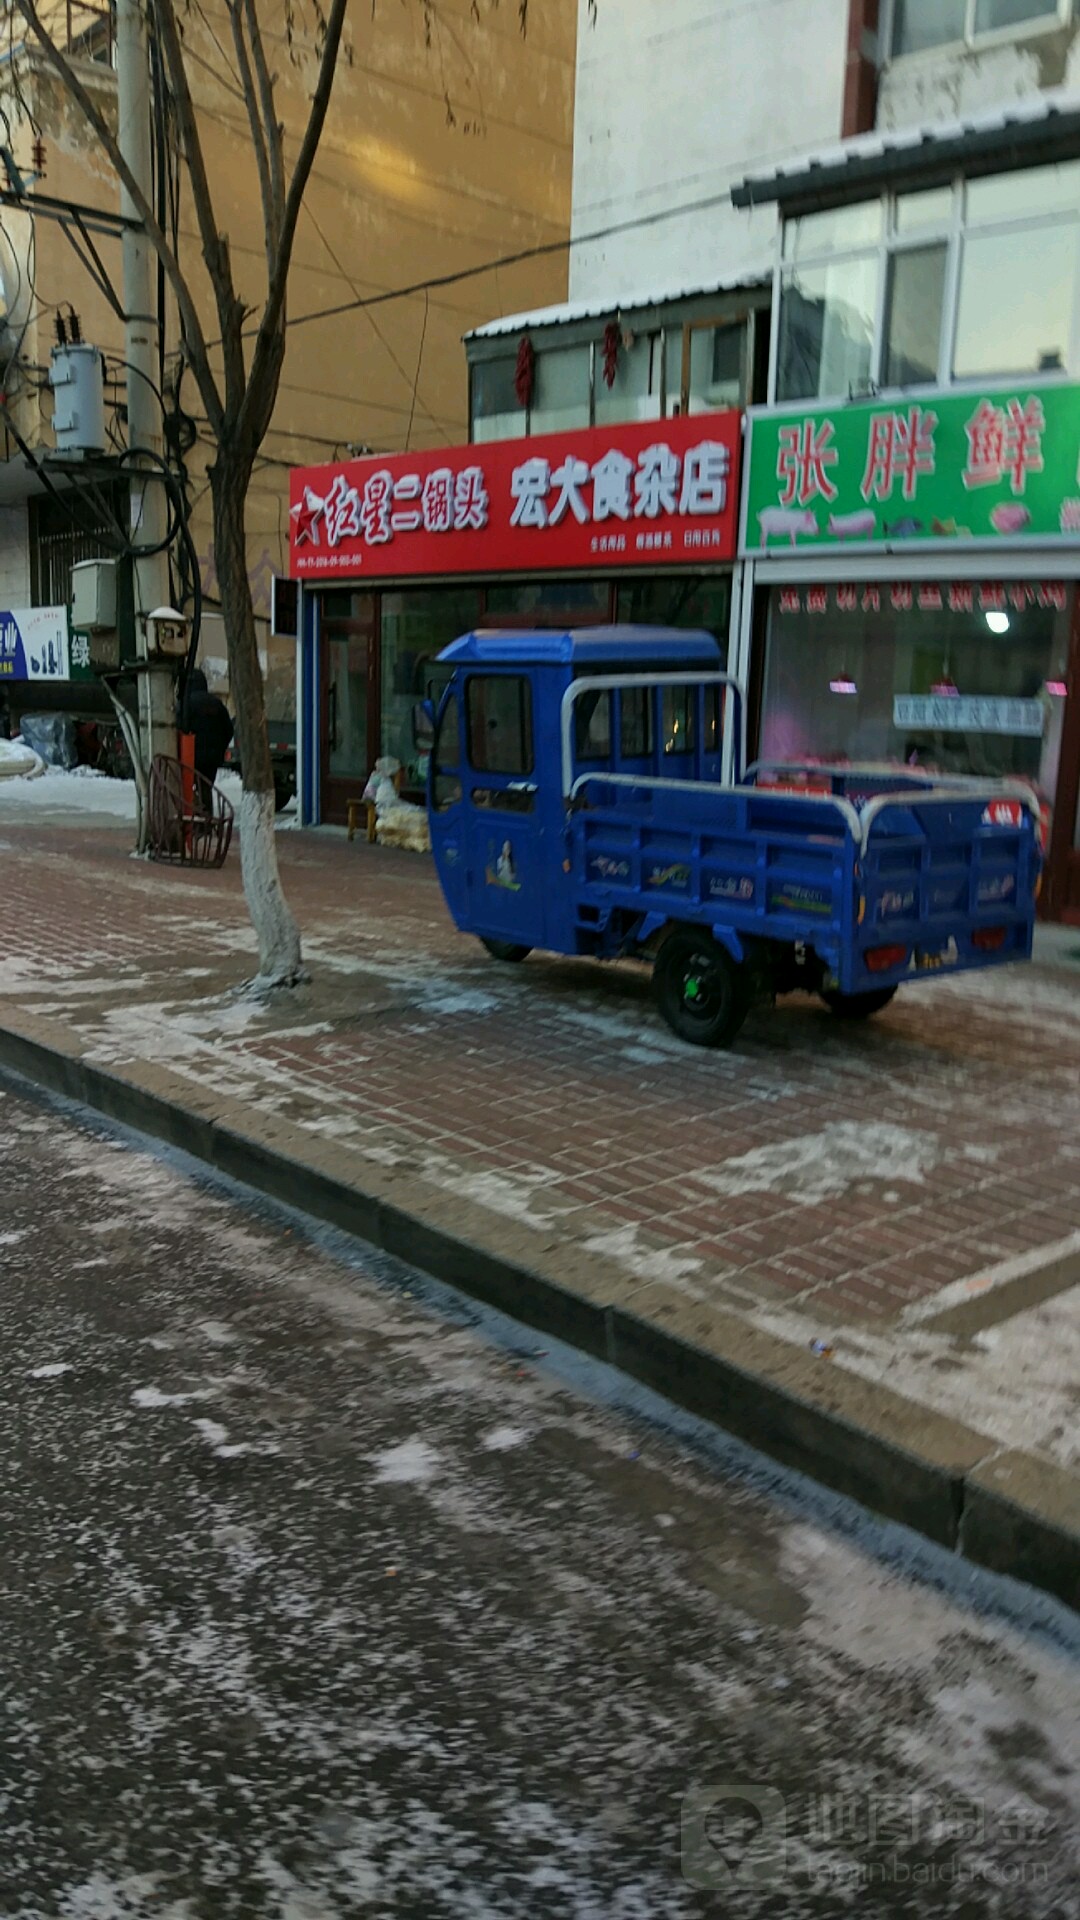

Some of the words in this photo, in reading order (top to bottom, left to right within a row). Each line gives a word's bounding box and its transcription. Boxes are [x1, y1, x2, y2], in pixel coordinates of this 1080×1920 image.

[510, 439, 729, 528] 宏大食杂店
[776, 395, 1080, 507] 张胖鲜
[324, 465, 488, 545] 红星二锅头
